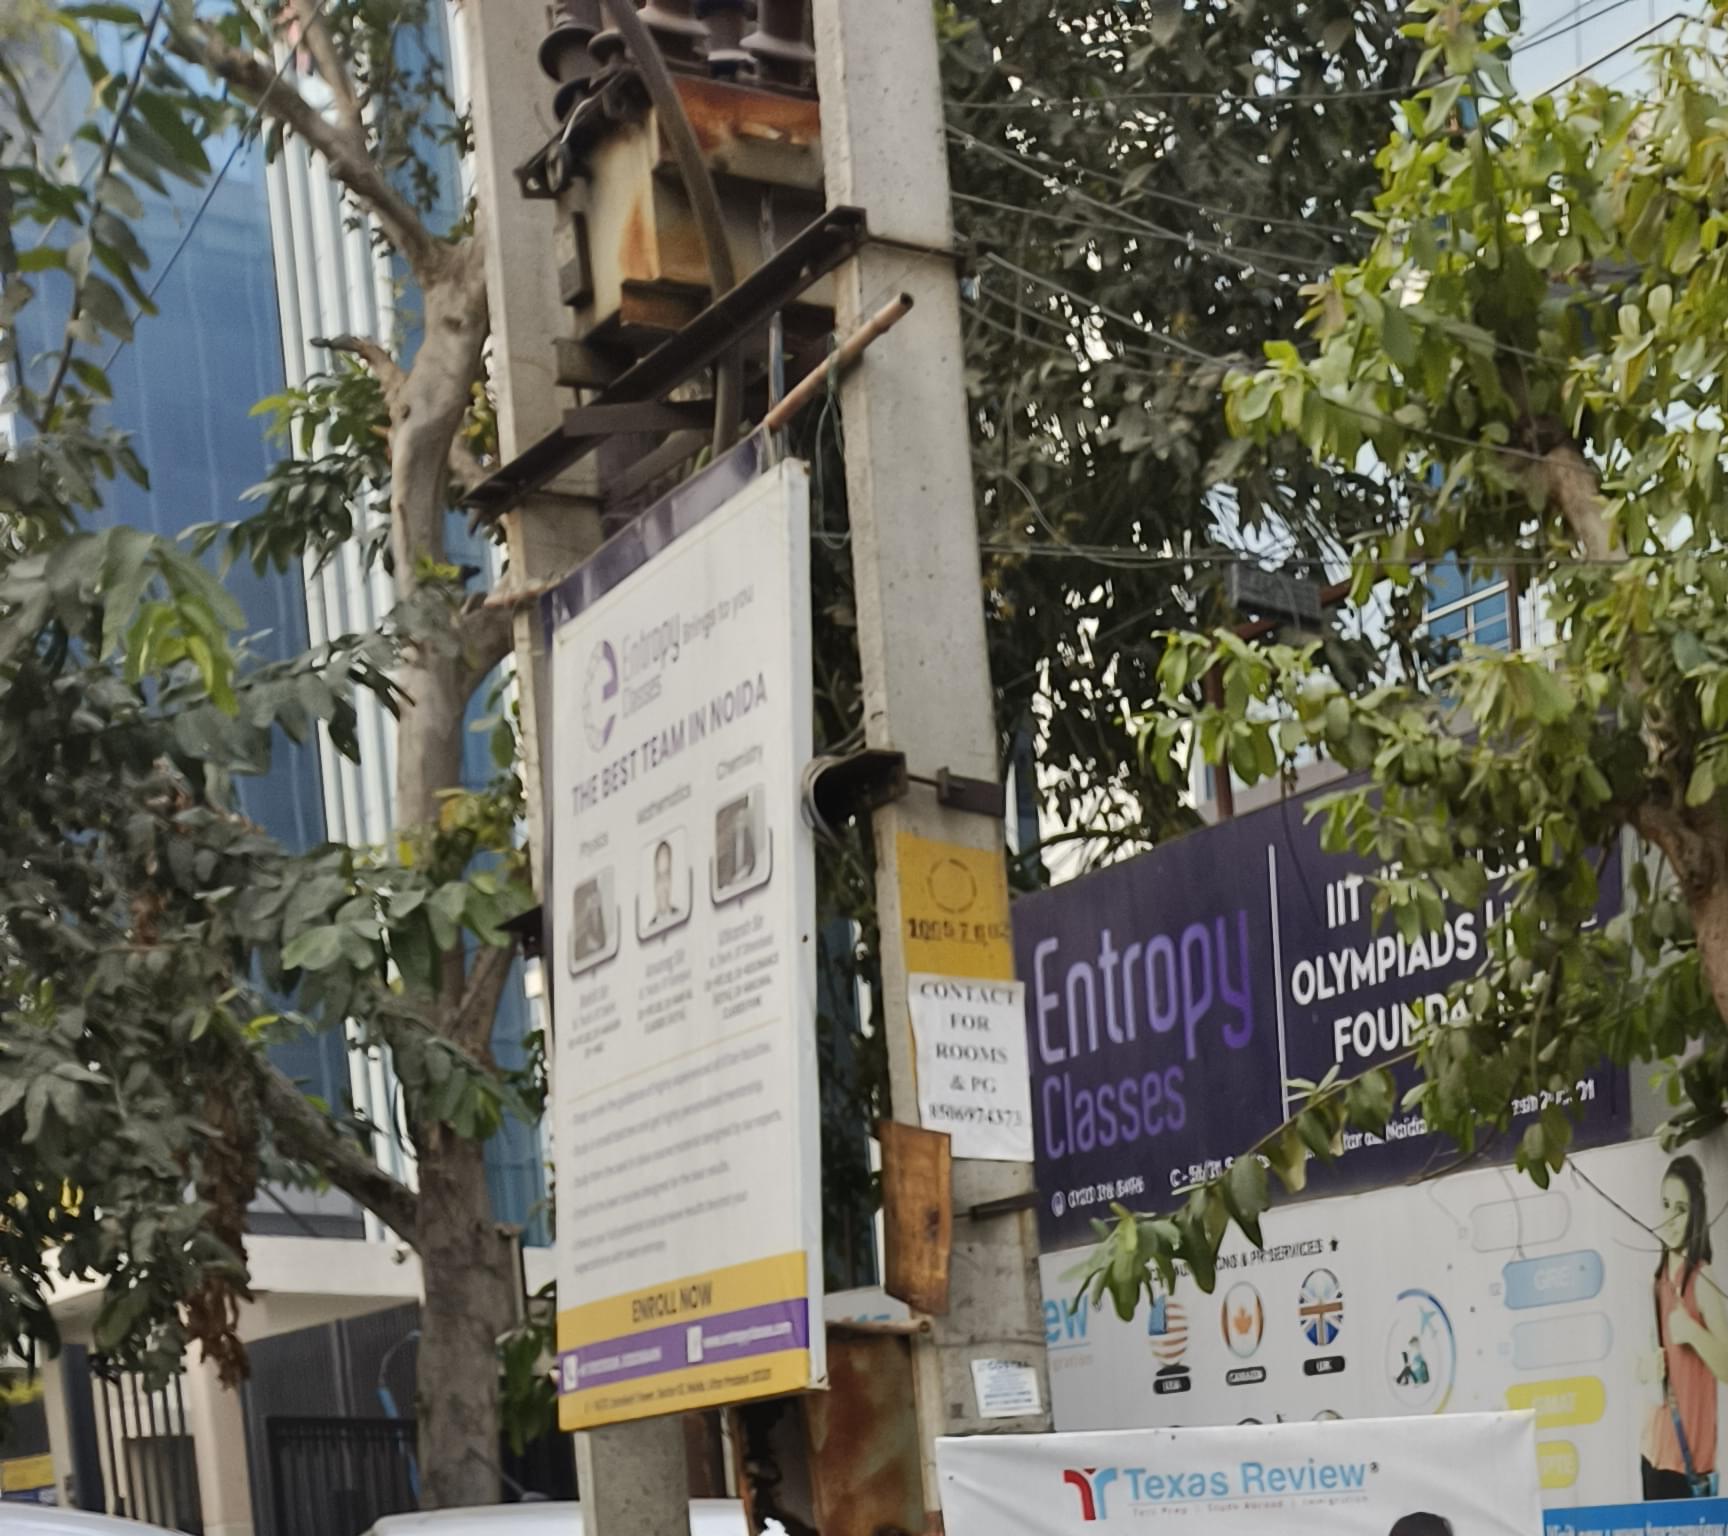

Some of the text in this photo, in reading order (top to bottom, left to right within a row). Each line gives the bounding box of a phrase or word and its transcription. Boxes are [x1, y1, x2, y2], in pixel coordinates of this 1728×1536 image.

[573, 671, 767, 816] THE BEST TEAM IN NOIDA
[1327, 875, 1363, 929] IIT
[1291, 911, 1477, 1006] OLYMPIADS
[920, 982, 1014, 1006] CONTACT
[1034, 909, 1254, 1065] Entropy
[951, 1013, 991, 1032] FOR
[1333, 994, 1474, 1063] FOUNDA
[935, 1042, 1008, 1065] ROOMS
[971, 1076, 996, 1093] PG
[1042, 1065, 1187, 1160] Classes
[632, 1281, 713, 1324] ENROLL NOW
[1123, 1467, 1230, 1501] Texas
